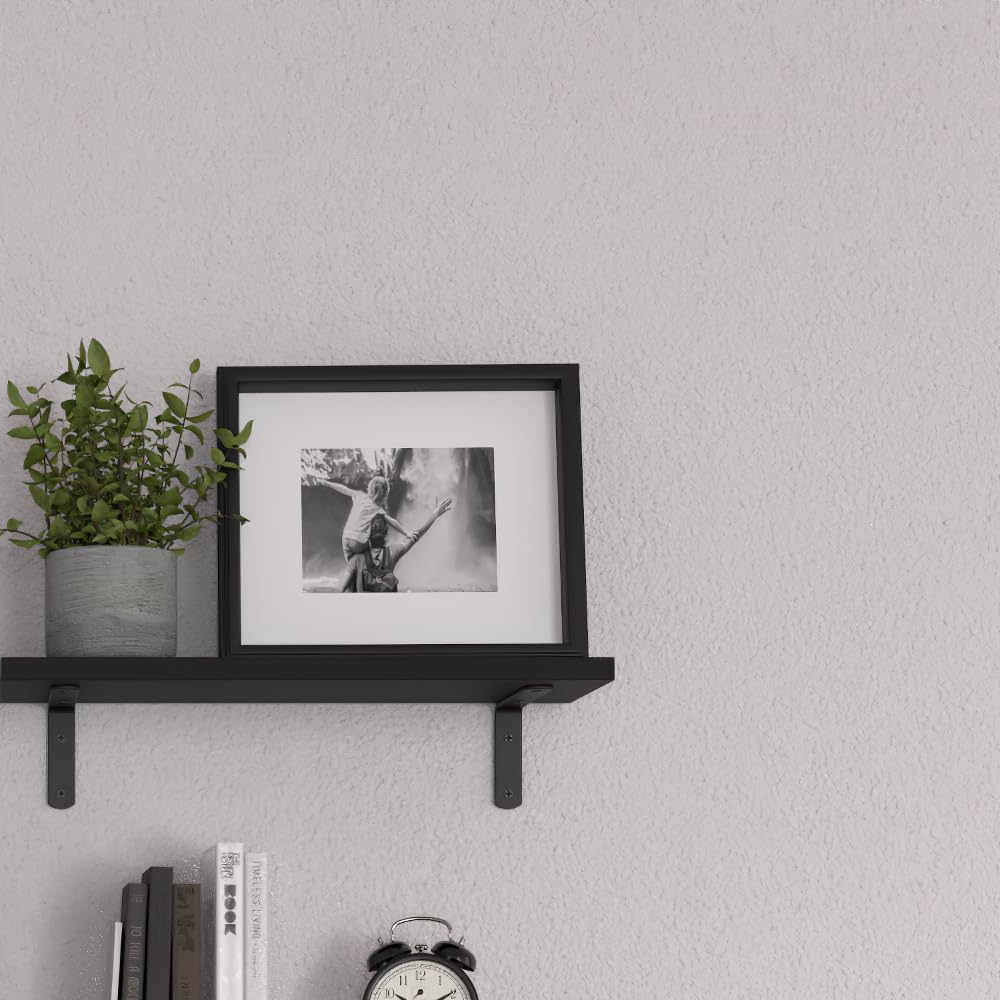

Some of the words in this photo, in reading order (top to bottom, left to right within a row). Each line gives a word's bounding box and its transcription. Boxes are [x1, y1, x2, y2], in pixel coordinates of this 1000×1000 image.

[399, 975, 408, 986] 11
[415, 970, 426, 981] 12
[438, 975, 443, 986] 1
[385, 988, 395, 999] 10
